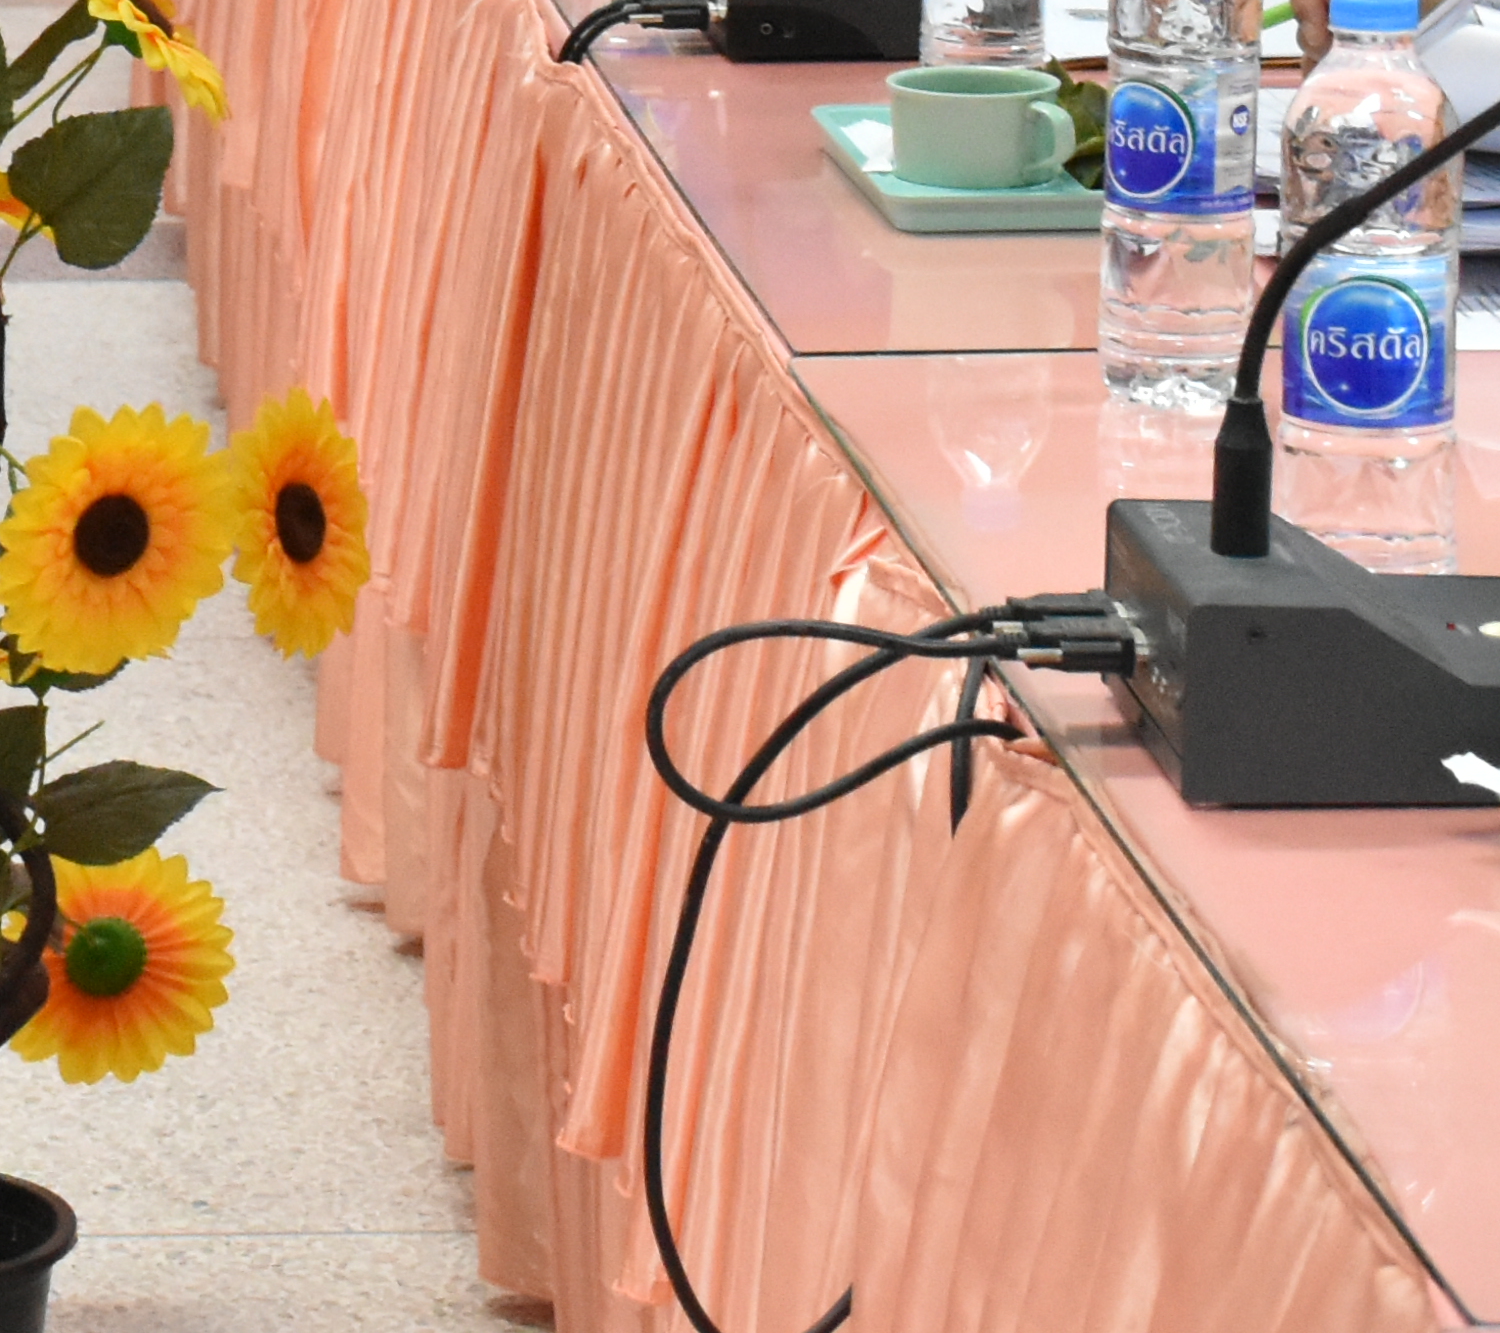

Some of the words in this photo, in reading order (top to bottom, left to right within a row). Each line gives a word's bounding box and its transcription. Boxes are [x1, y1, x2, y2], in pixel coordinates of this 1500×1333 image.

[1112, 120, 1186, 154] ริสตัล
[1310, 326, 1421, 361] คริสตัล
